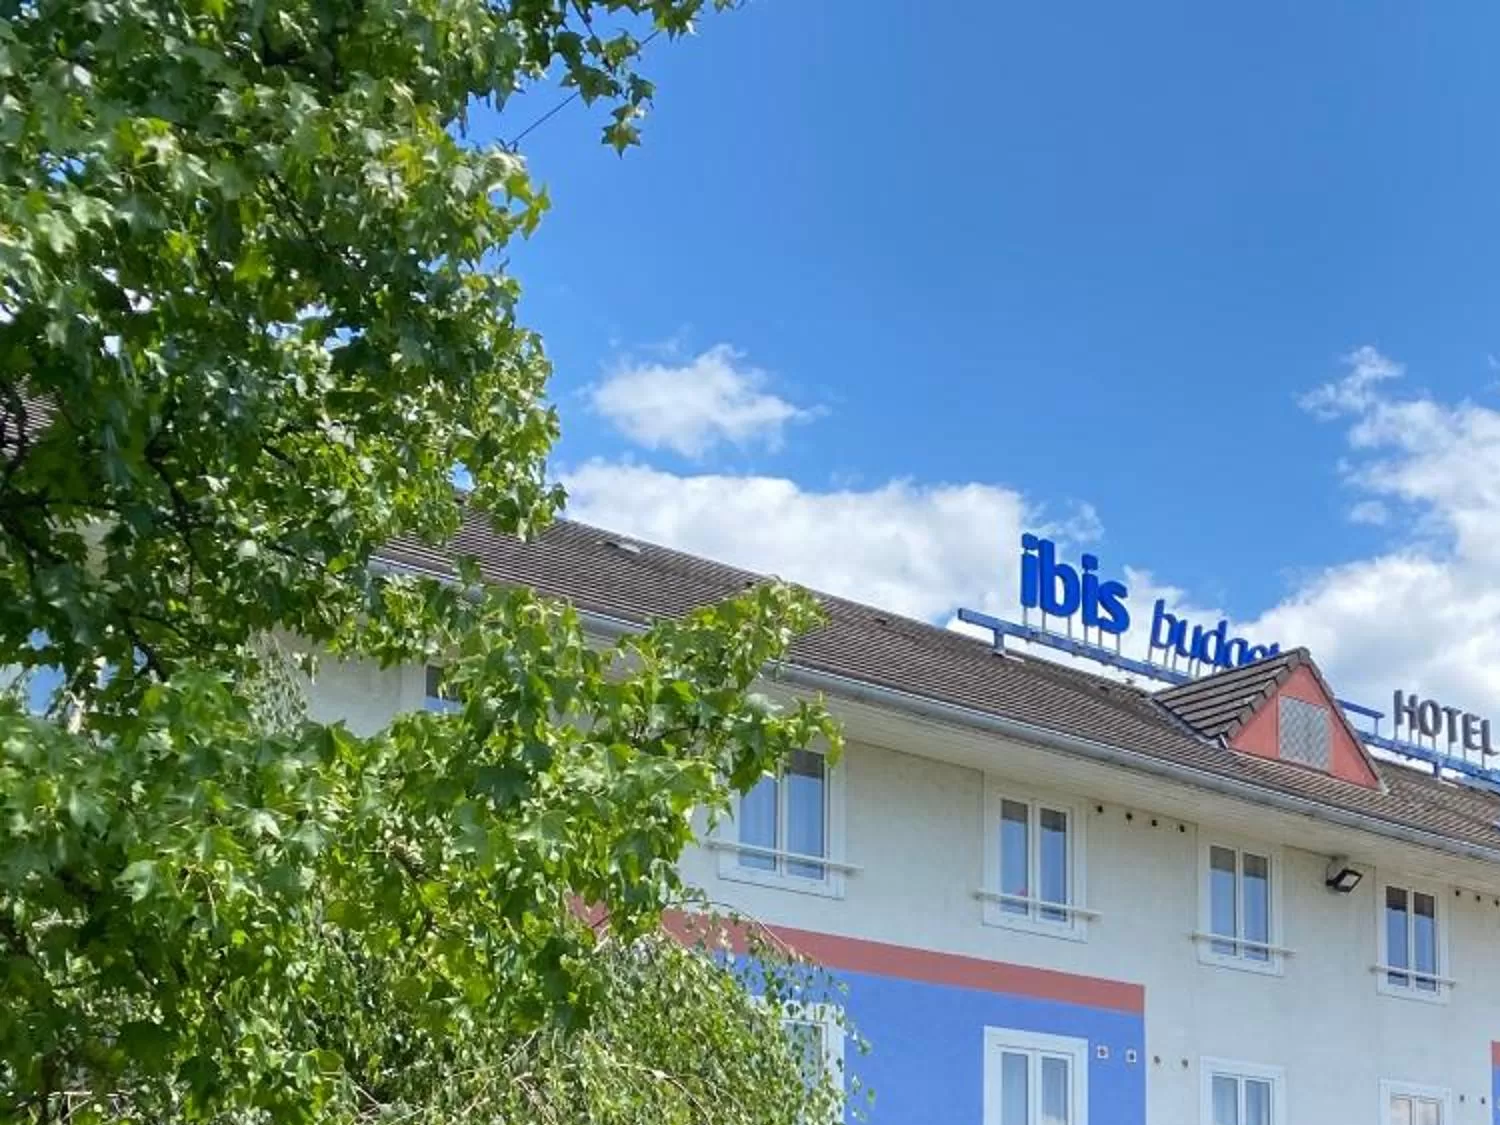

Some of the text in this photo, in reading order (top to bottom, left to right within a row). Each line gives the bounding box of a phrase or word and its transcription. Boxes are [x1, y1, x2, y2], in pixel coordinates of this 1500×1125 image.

[1020, 532, 1279, 669] ibis budg
[1393, 689, 1500, 756] HOTEL
